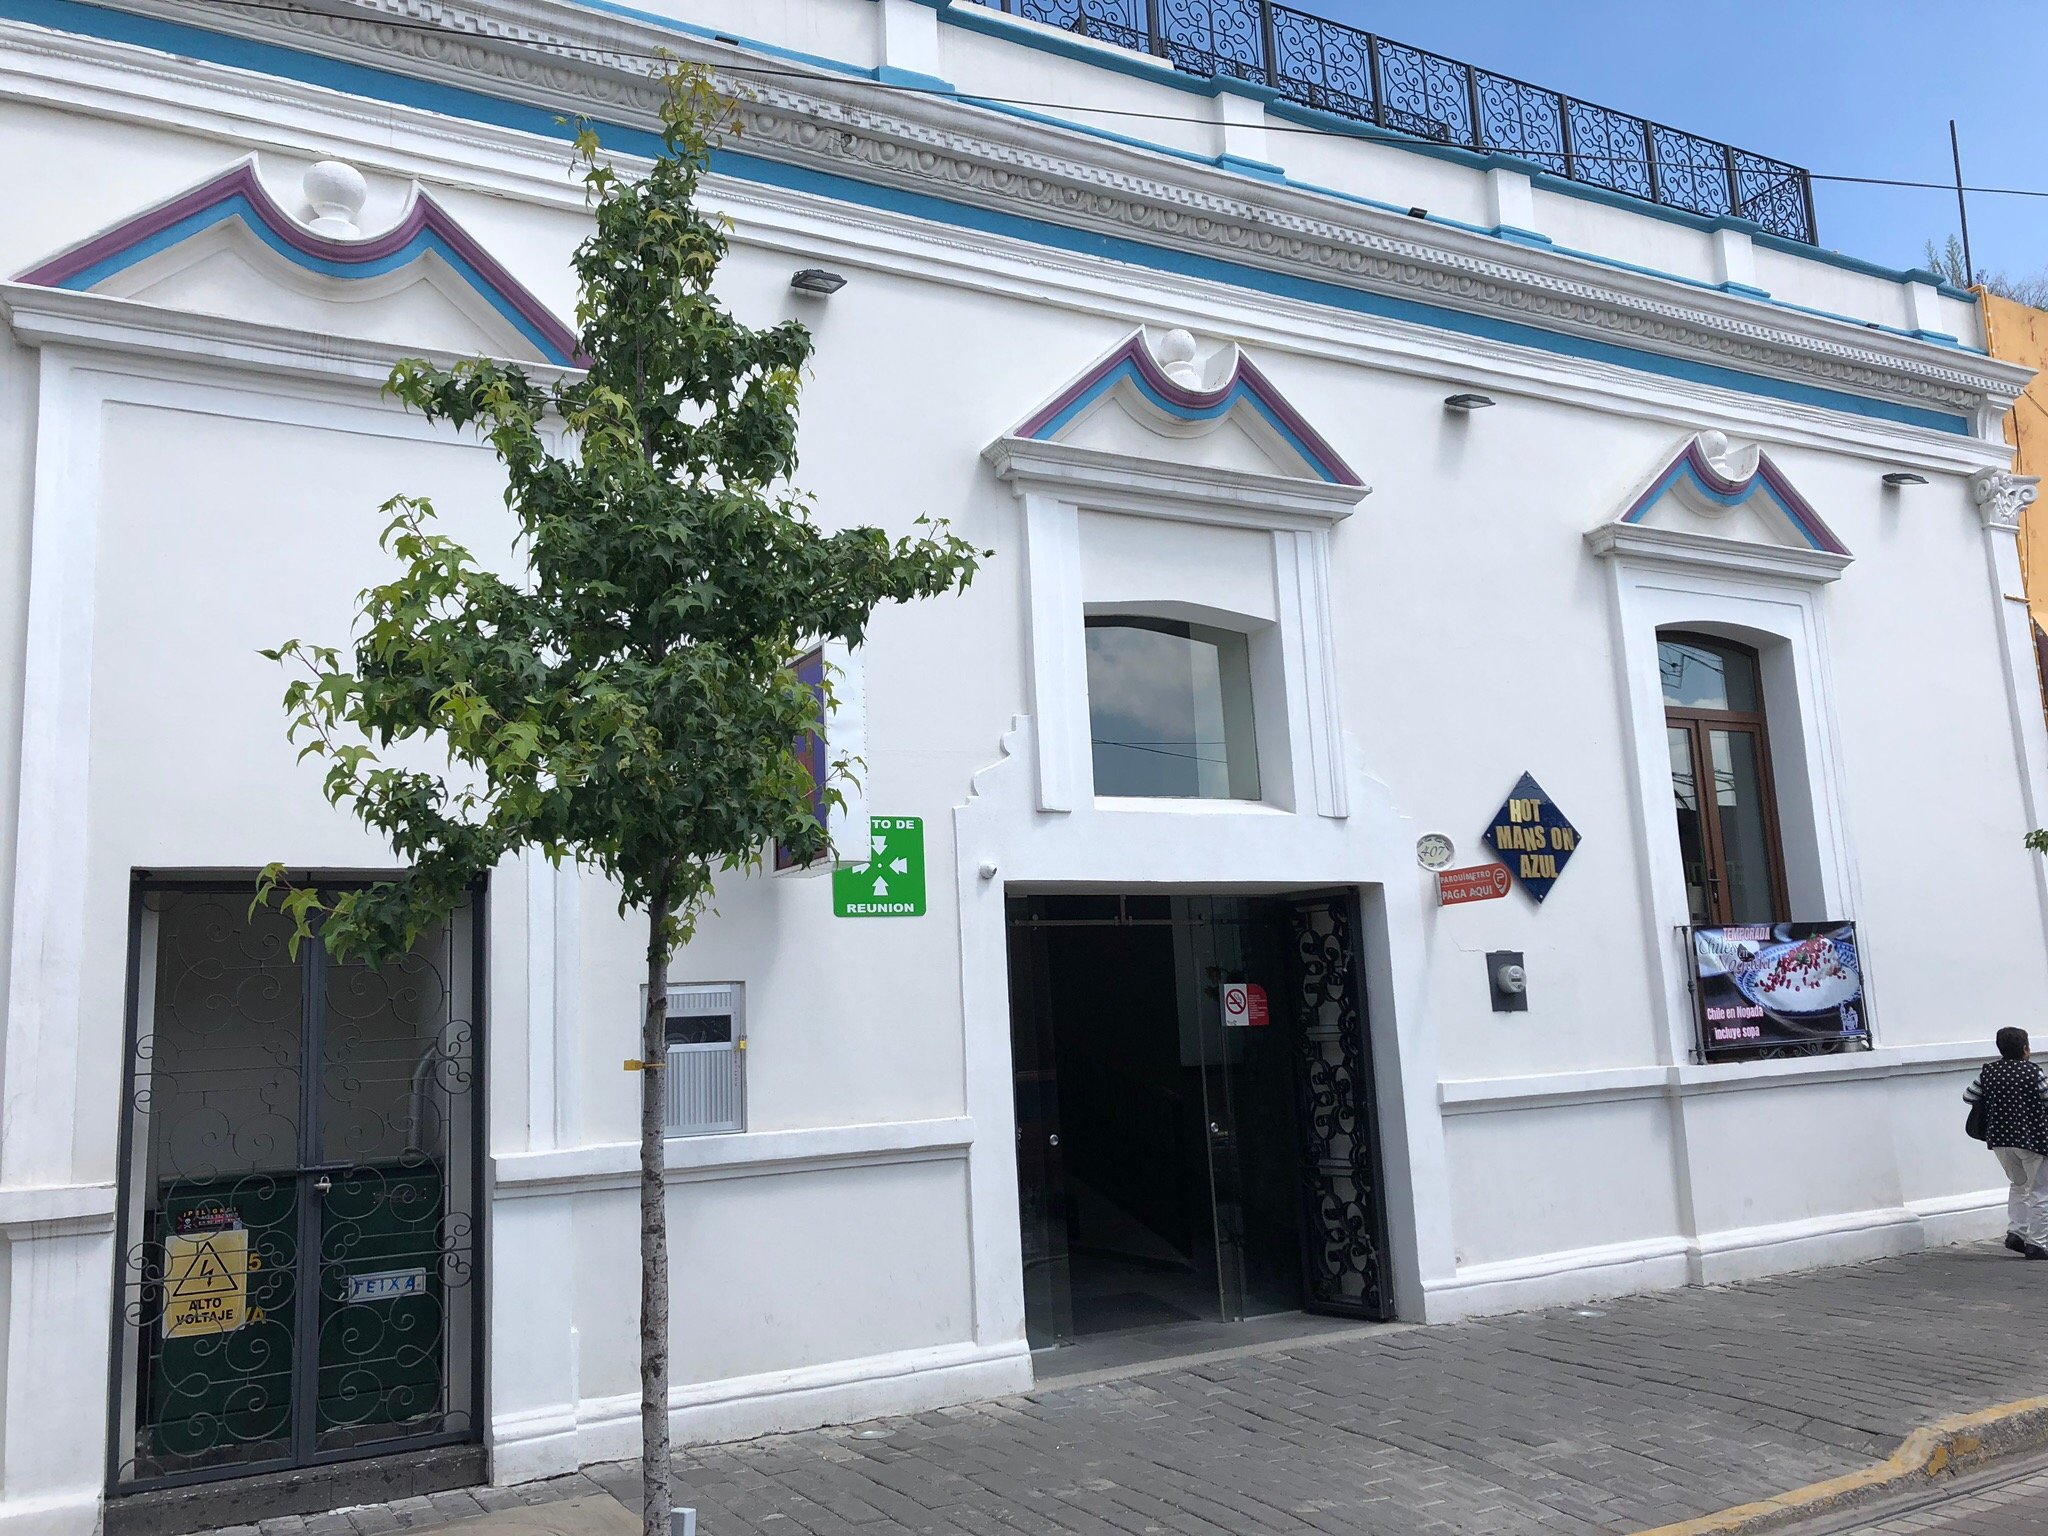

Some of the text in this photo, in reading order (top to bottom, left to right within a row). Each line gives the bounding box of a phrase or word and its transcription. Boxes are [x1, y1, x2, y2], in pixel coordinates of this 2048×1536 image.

[1509, 799, 1541, 823] HOT
[871, 819, 915, 829] TO DE
[1497, 825, 1575, 851] MANS ON
[1421, 845, 1445, 857] 407
[1520, 854, 1558, 879] AZUL
[1442, 885, 1493, 900] PAGA AQUI
[846, 903, 914, 914] REUNION
[1723, 927, 1771, 941] TEMPORADA
[1707, 1004, 1764, 1020] Chile en Nogada
[1715, 1025, 1760, 1040] incluye sopa
[189, 1298, 222, 1311] ALTO
[176, 1309, 234, 1325] VOLTAJE
